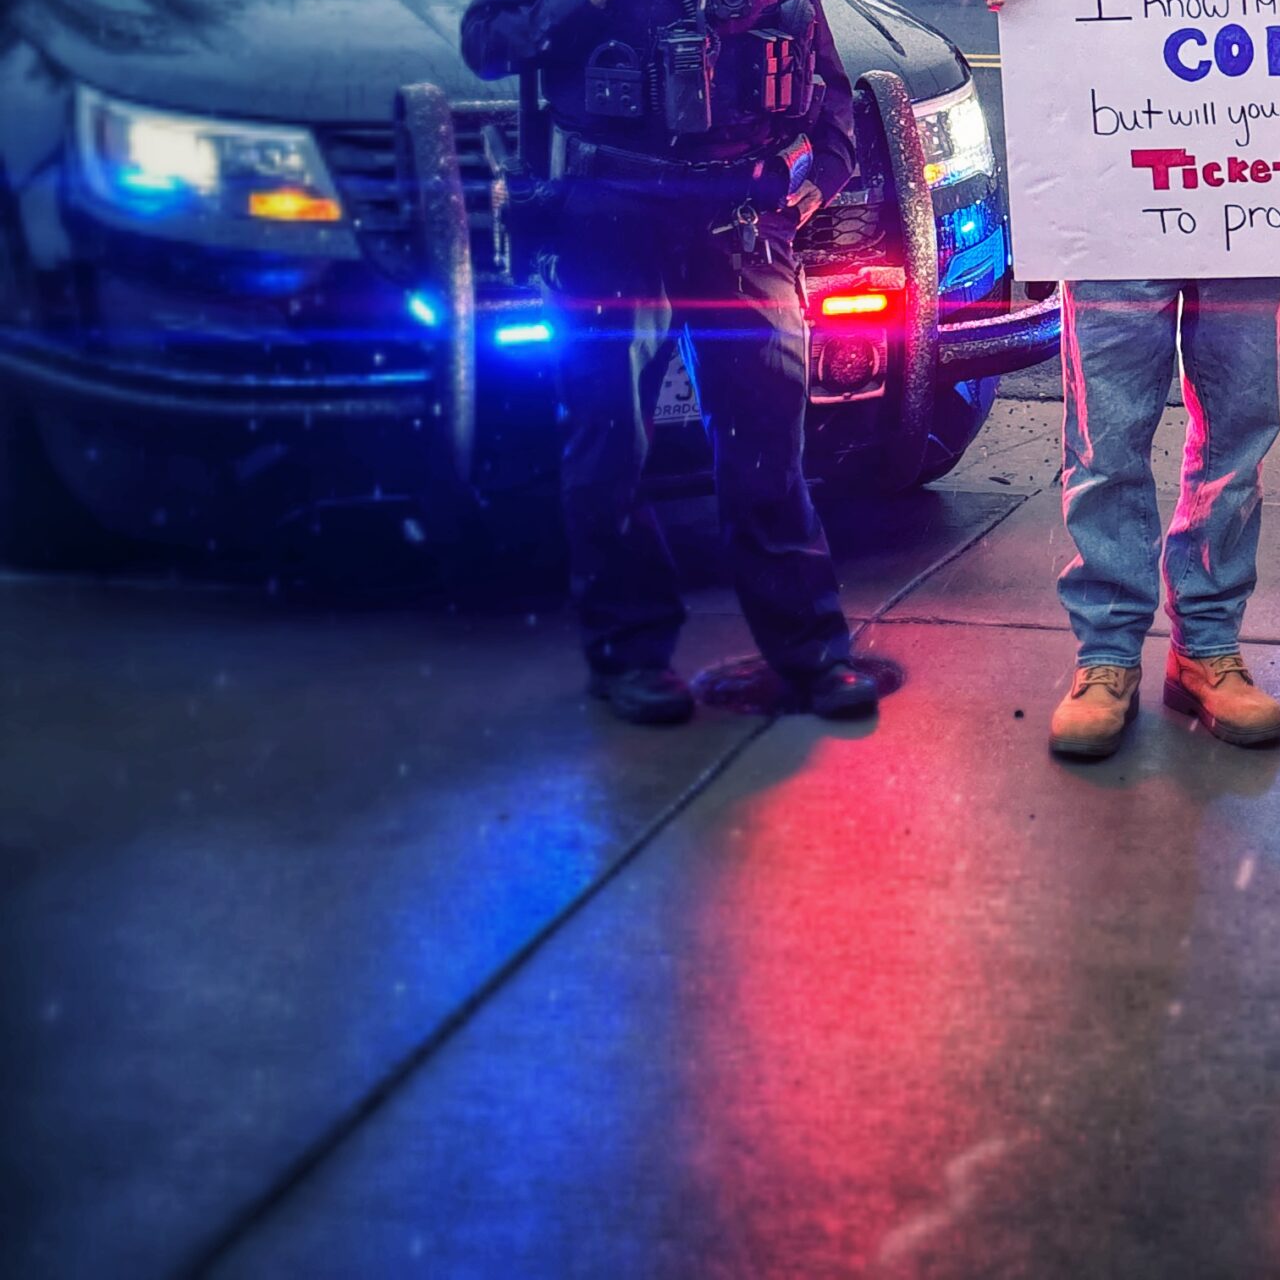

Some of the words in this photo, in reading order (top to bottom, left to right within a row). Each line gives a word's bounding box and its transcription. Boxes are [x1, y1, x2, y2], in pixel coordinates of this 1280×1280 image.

[1091, 88, 1164, 136] but
[1167, 101, 1217, 127] will
[1227, 101, 1280, 147] you
